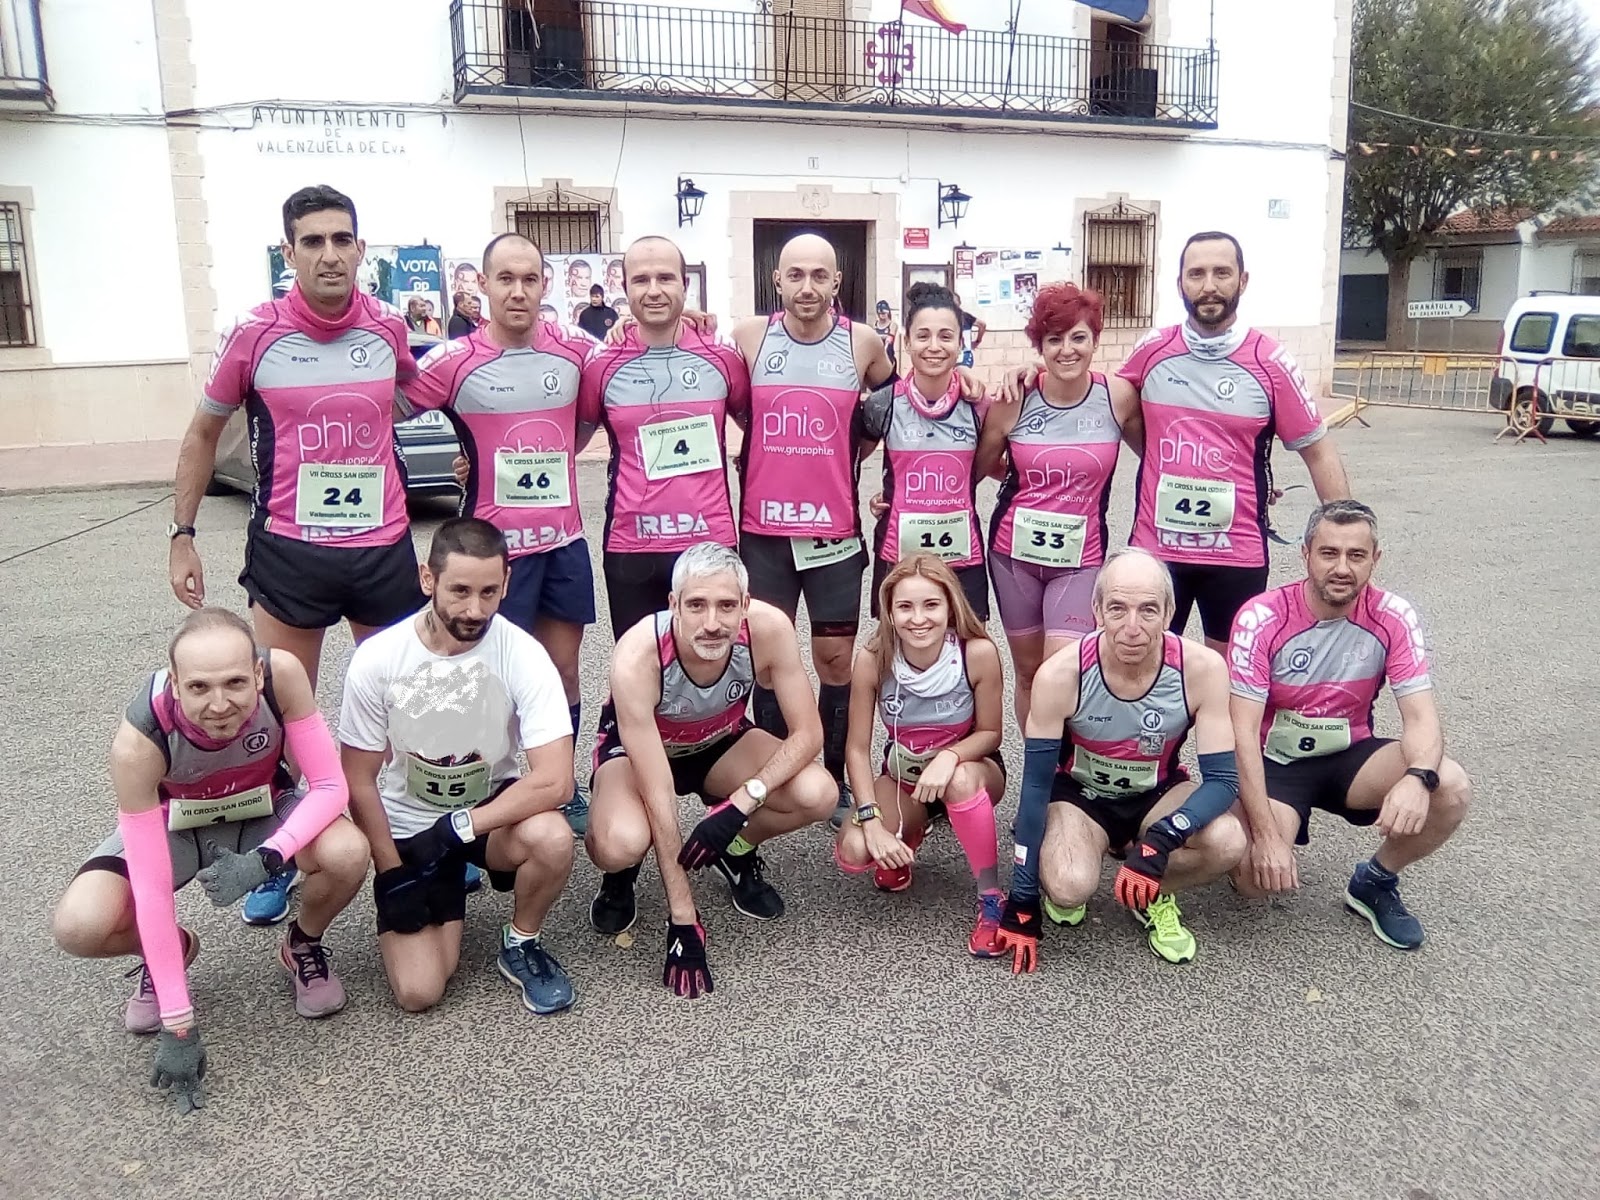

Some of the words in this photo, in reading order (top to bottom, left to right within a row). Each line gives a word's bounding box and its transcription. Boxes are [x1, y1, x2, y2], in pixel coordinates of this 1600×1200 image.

[254, 107, 405, 128] AYUNTAMIENTO
[325, 128, 342, 138] DE
[257, 140, 354, 153] VALENZUELA
[360, 141, 377, 153] DE
[400, 260, 438, 272] VOTA
[673, 439, 690, 455] 4
[517, 472, 550, 489] 46
[323, 488, 362, 505] 24
[1175, 498, 1211, 516] 42
[920, 531, 953, 548] 16
[1031, 530, 1065, 549] 33
[1299, 737, 1316, 752] 8
[424, 769, 446, 780] CROSS
[1114, 762, 1128, 771] SAN
[1092, 771, 1132, 789] 34
[426, 781, 467, 797] 15
[193, 807, 219, 816] CROSS
[221, 803, 237, 811] SAN
[238, 796, 262, 807] ISIDRO
